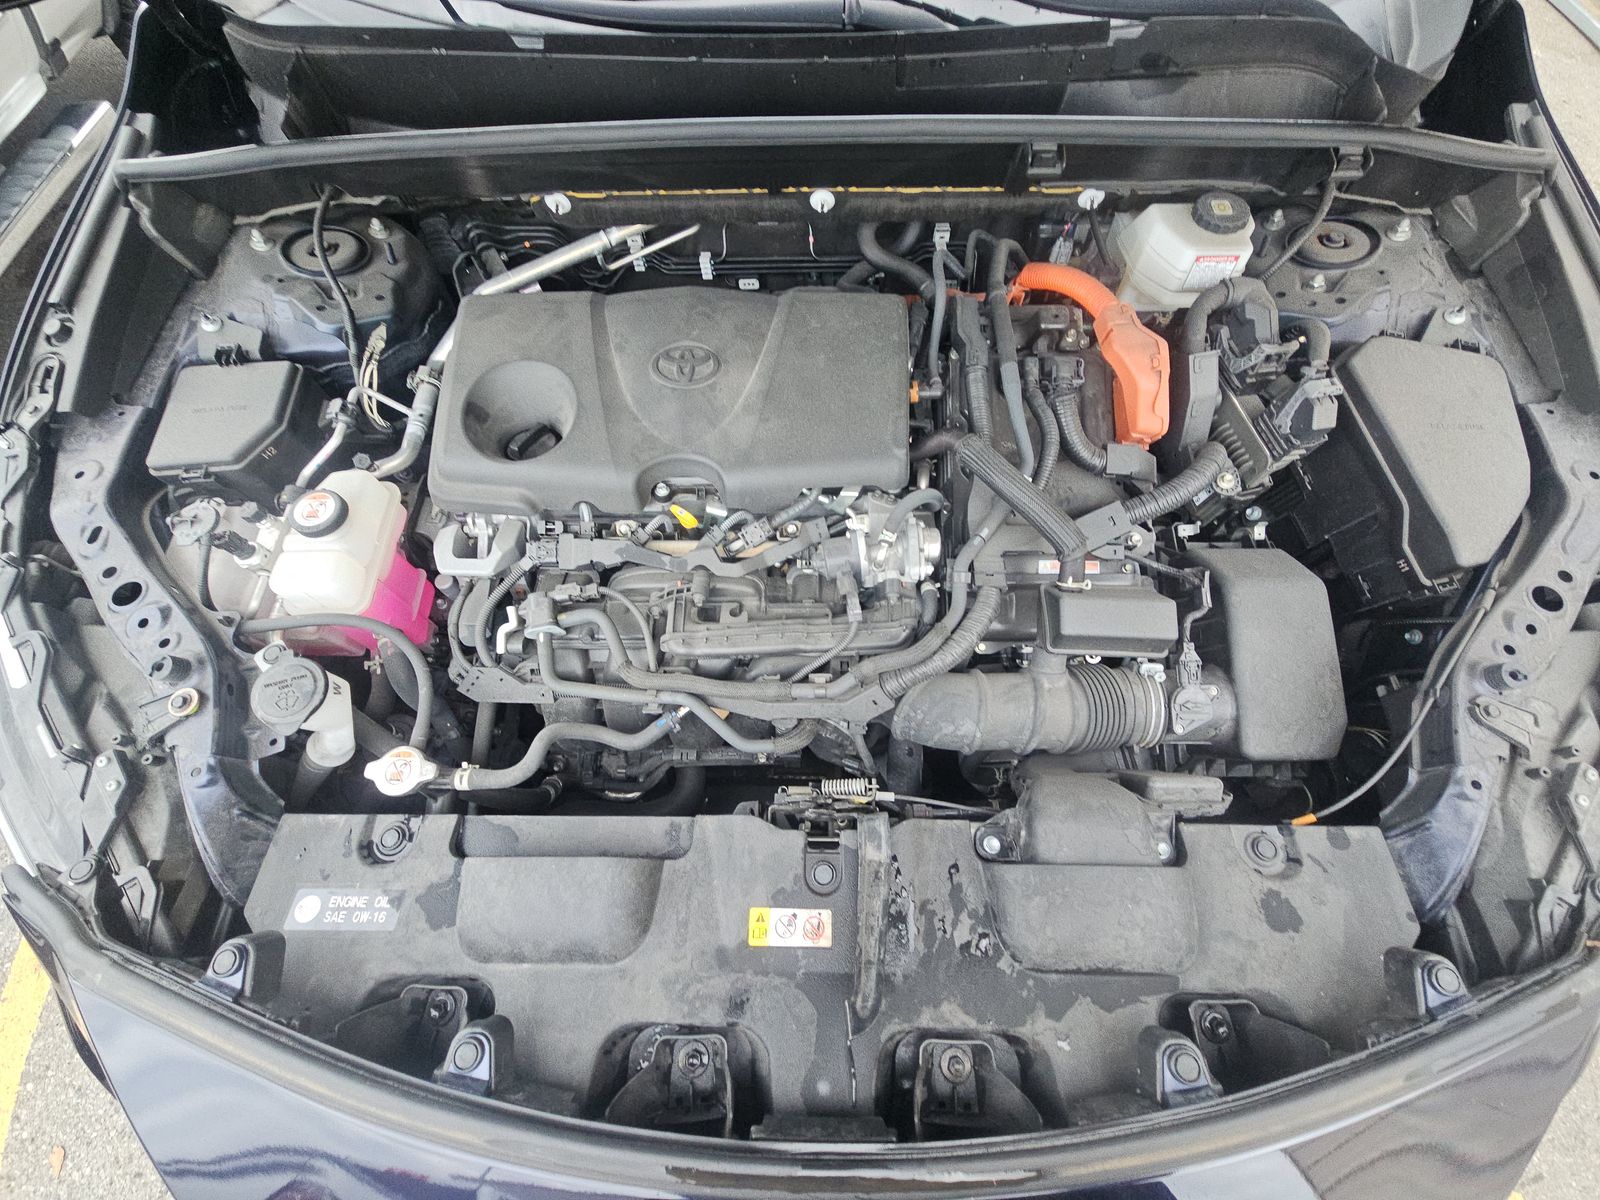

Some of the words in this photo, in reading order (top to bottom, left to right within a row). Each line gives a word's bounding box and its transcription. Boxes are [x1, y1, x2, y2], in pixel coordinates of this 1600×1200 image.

[328, 895, 369, 909] ENGINE
[374, 895, 391, 909] OIL
[322, 911, 347, 923] SAE
[352, 911, 387, 923] 0W-16
